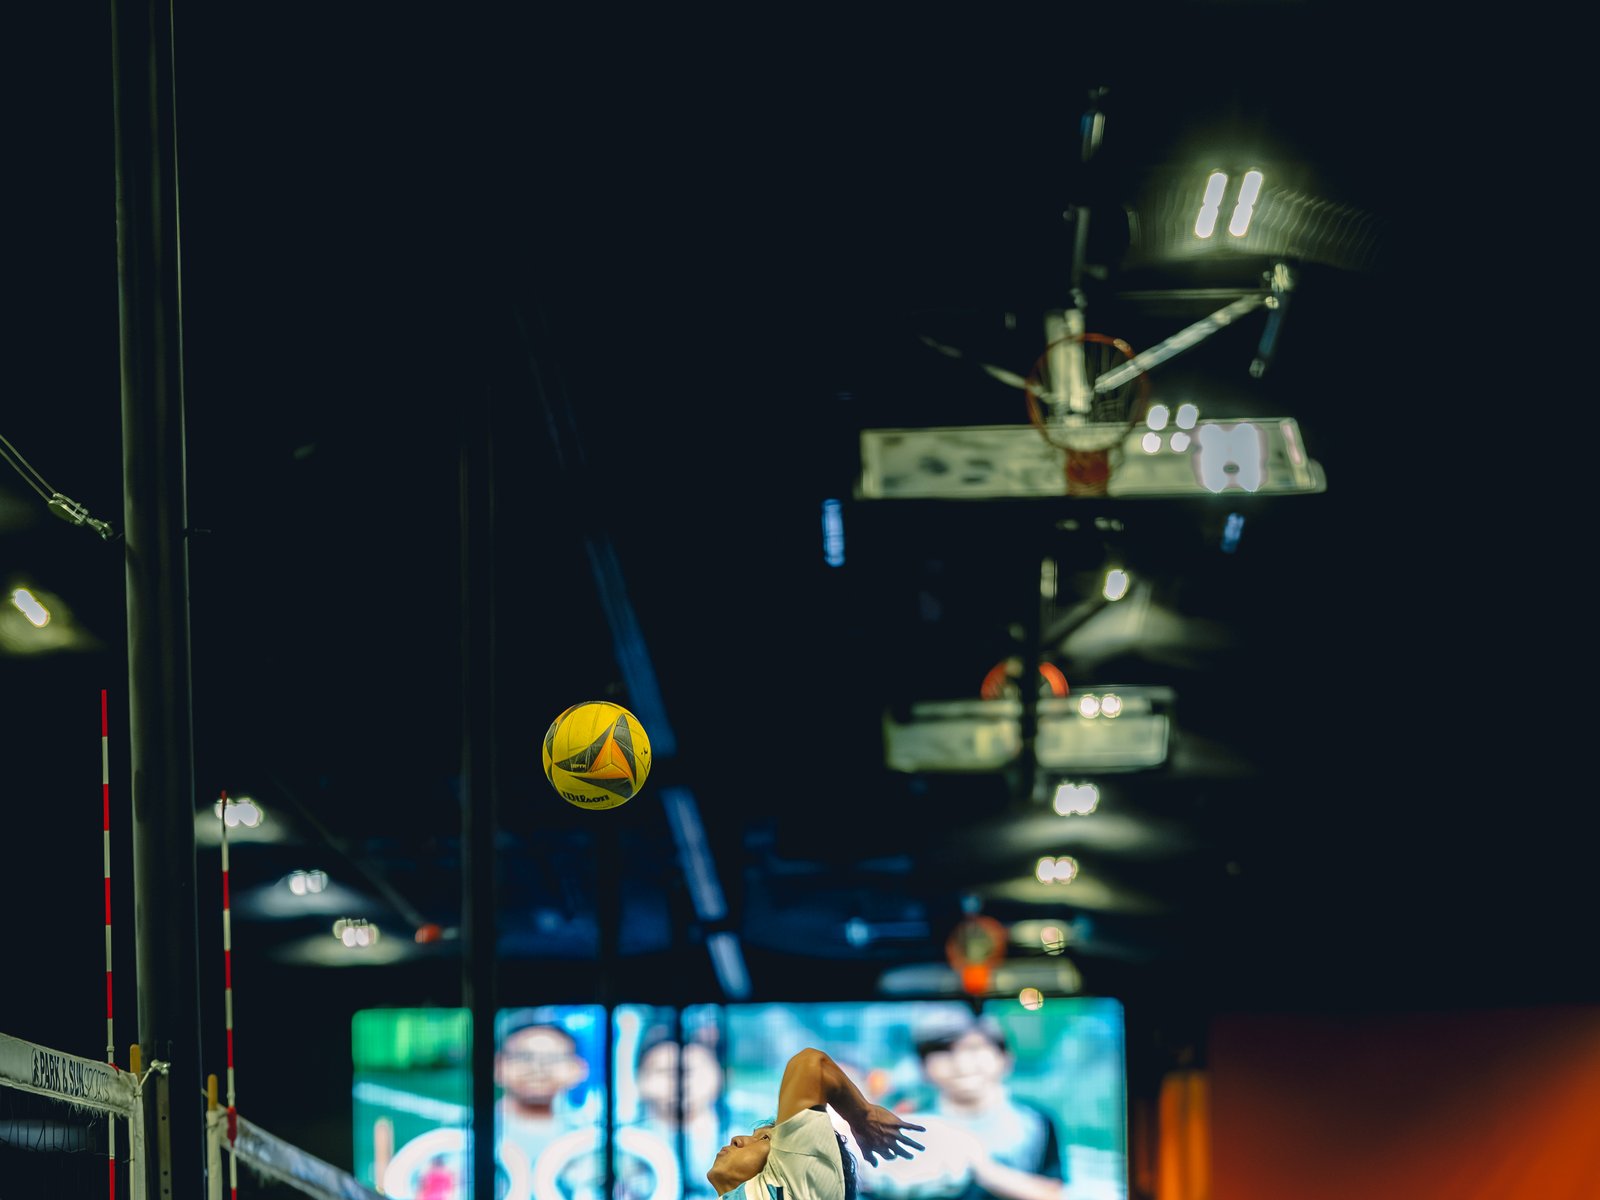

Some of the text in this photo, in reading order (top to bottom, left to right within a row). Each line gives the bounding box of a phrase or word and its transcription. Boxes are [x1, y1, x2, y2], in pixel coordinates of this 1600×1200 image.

[562, 791, 610, 803] Wilson
[40, 1051, 61, 1091] PARK
[61, 1058, 69, 1094] &
